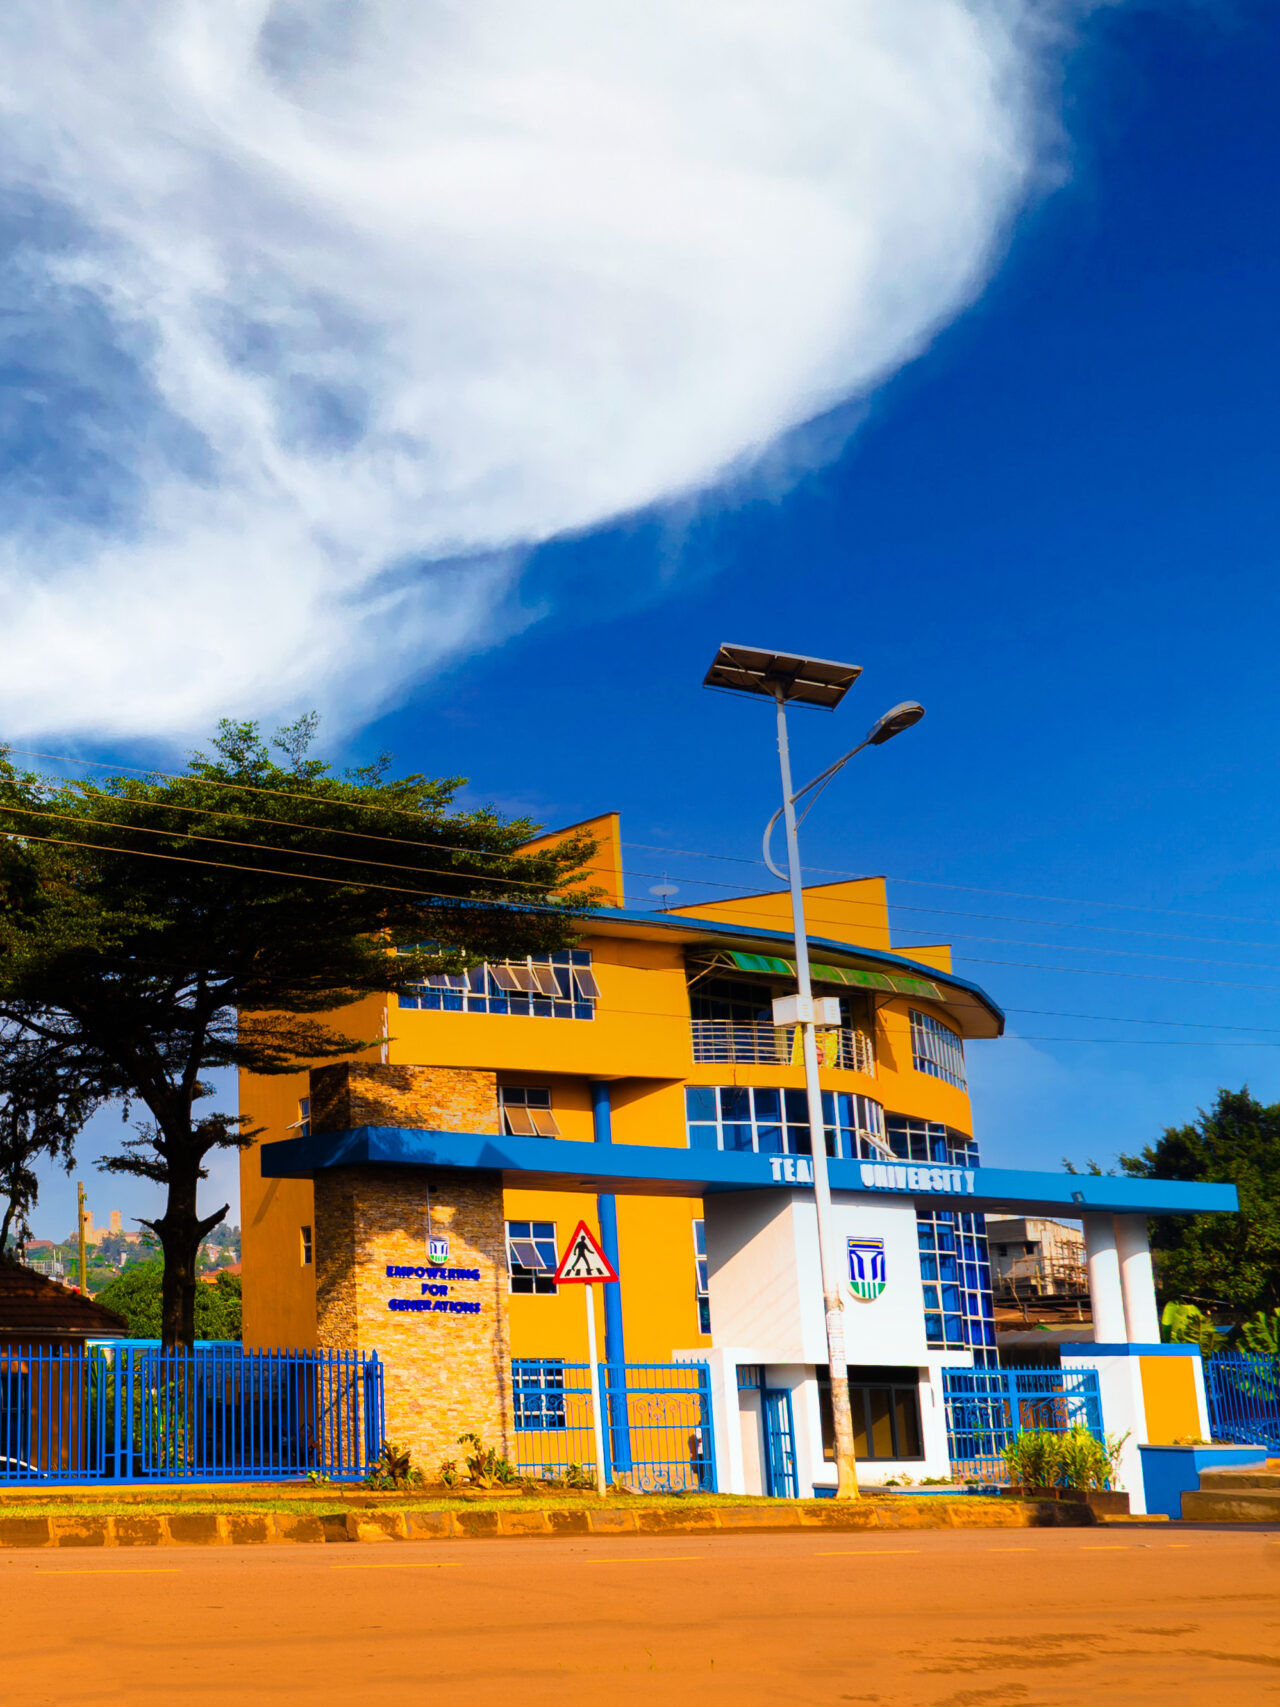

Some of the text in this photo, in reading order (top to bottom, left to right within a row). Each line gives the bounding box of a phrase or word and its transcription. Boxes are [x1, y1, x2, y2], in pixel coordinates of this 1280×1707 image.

[770, 1157, 975, 1194] TEA UNIVERSITY
[386, 1265, 480, 1281] EMPOWERING
[421, 1283, 448, 1296] FOR
[388, 1298, 481, 1314] GENERATIONS
